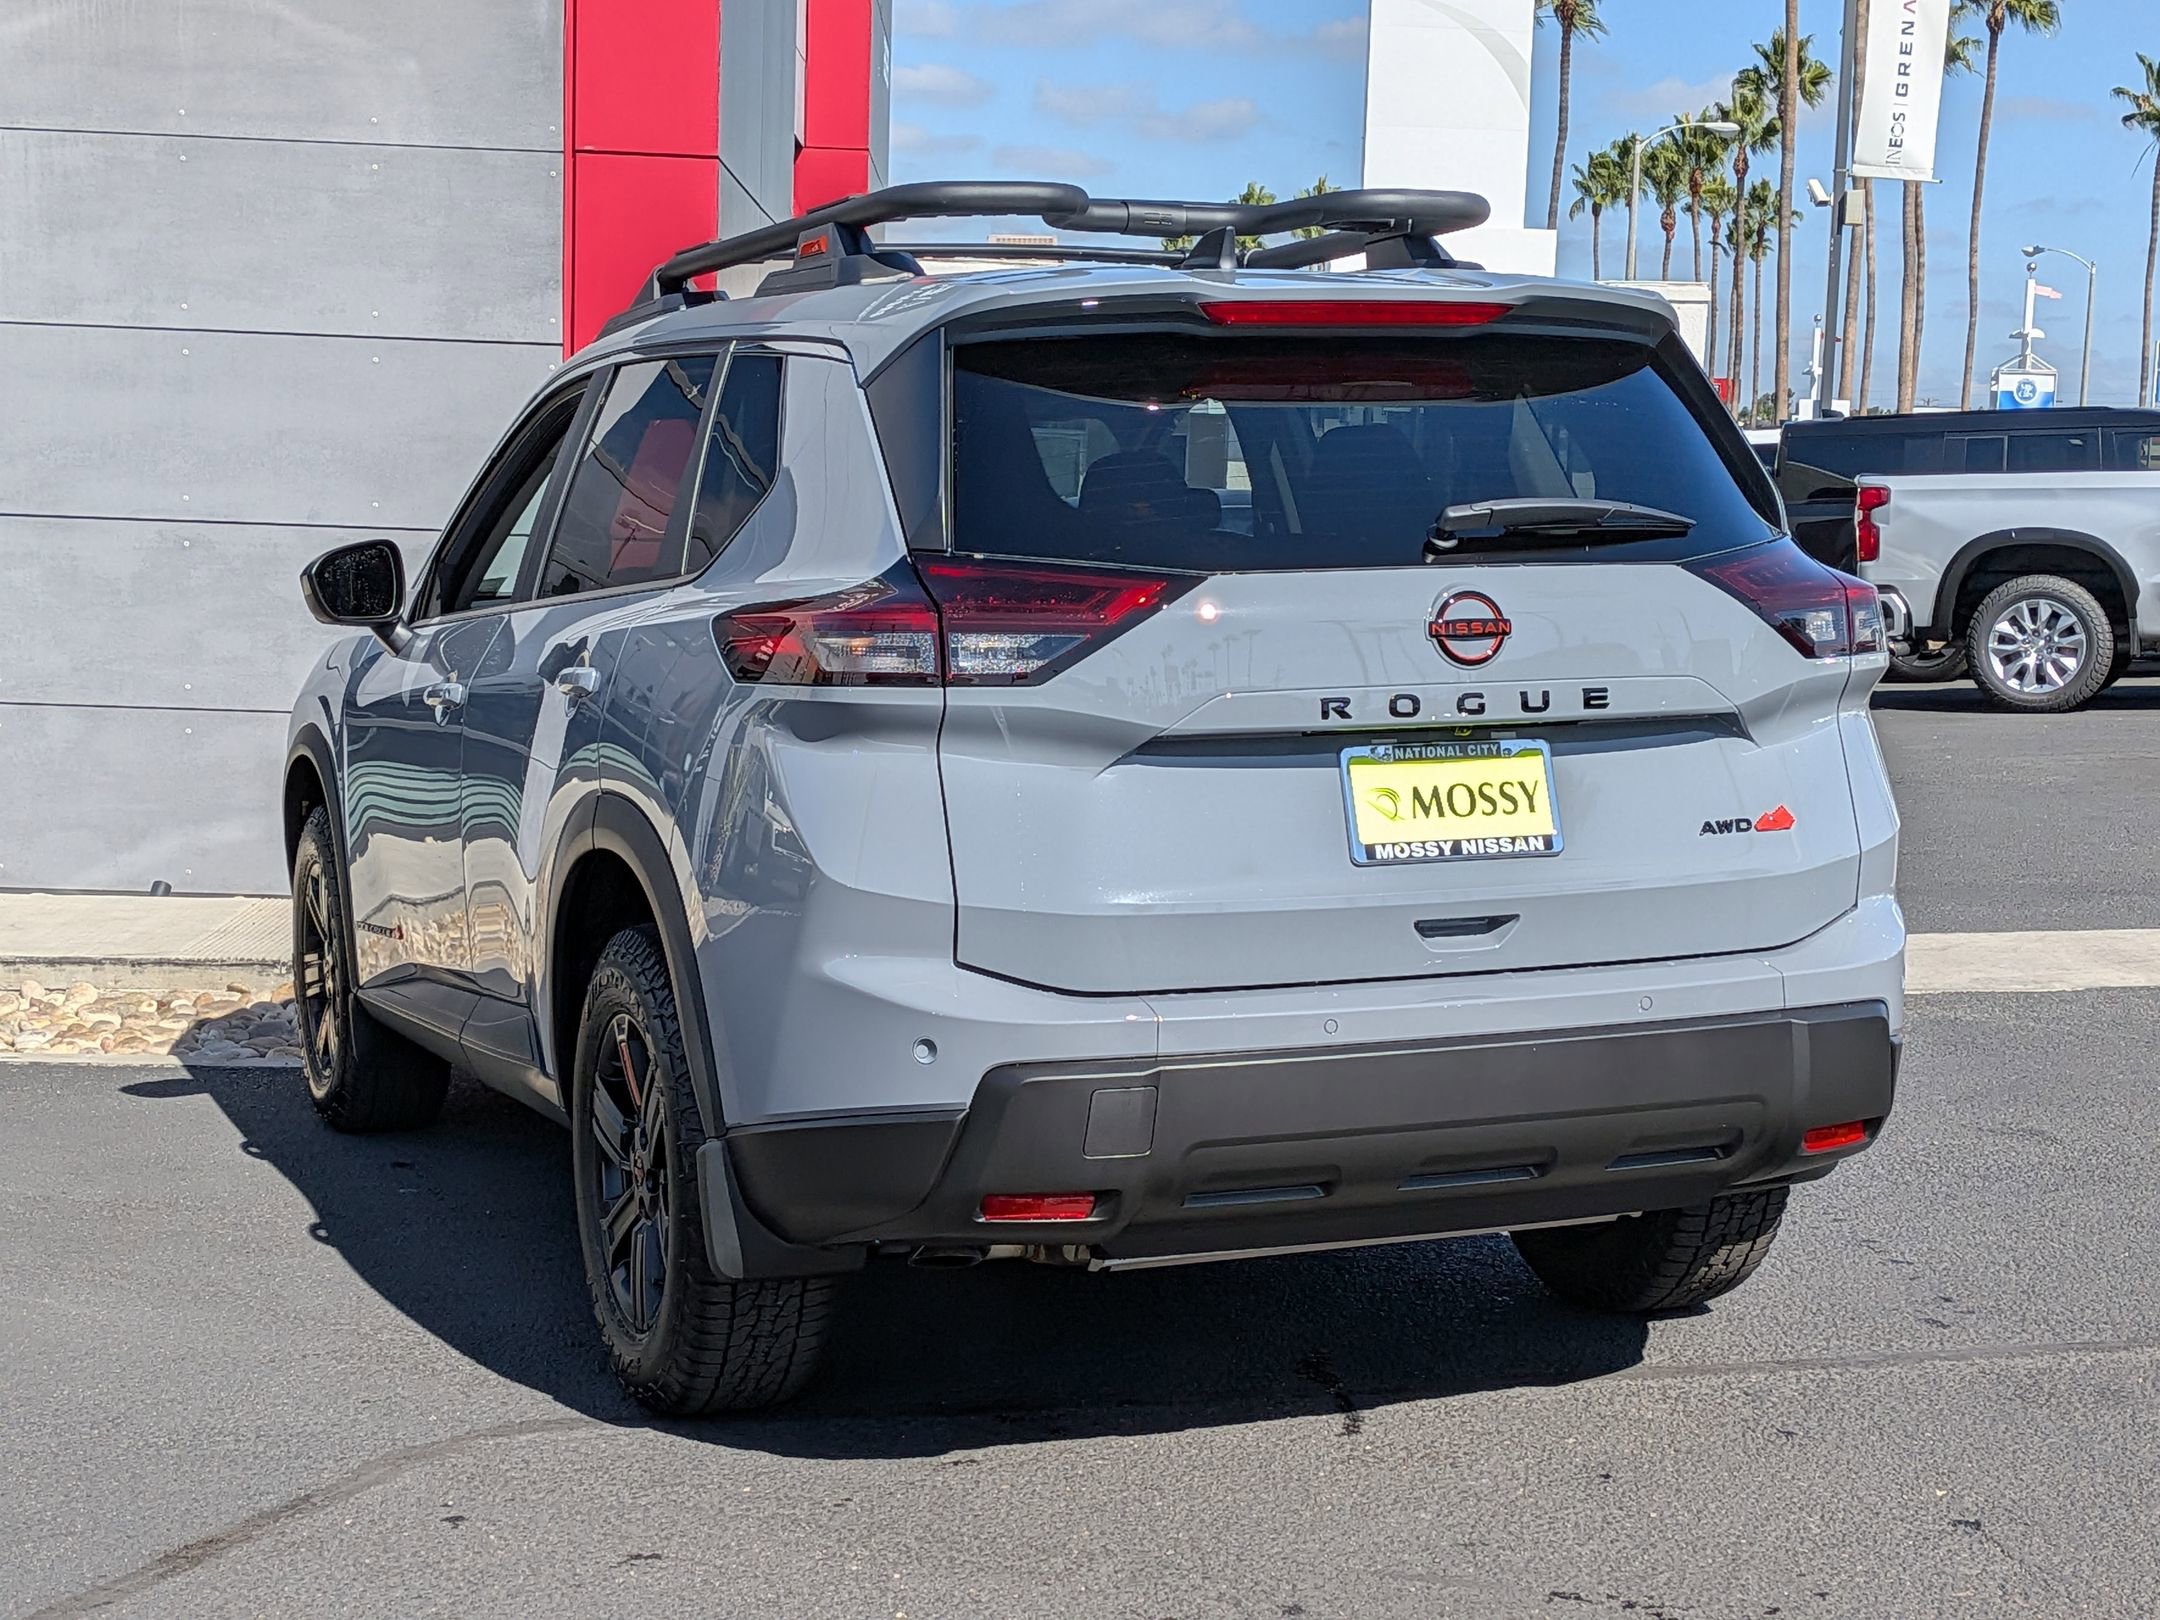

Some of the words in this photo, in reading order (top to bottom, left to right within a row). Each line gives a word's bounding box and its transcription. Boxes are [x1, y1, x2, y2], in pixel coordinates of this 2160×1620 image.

[1885, 112, 1906, 165] INEOS
[1431, 621, 1511, 636] NISSAN
[1320, 686, 1611, 720] ROGUE
[1394, 745, 1467, 760] NATIONAL
[1470, 743, 1500, 757] CITY
[1412, 780, 1539, 819] MOSSY
[1699, 818, 1753, 836] AWD
[1375, 841, 1457, 860] MOSSY
[1462, 836, 1545, 855] NISSAN
